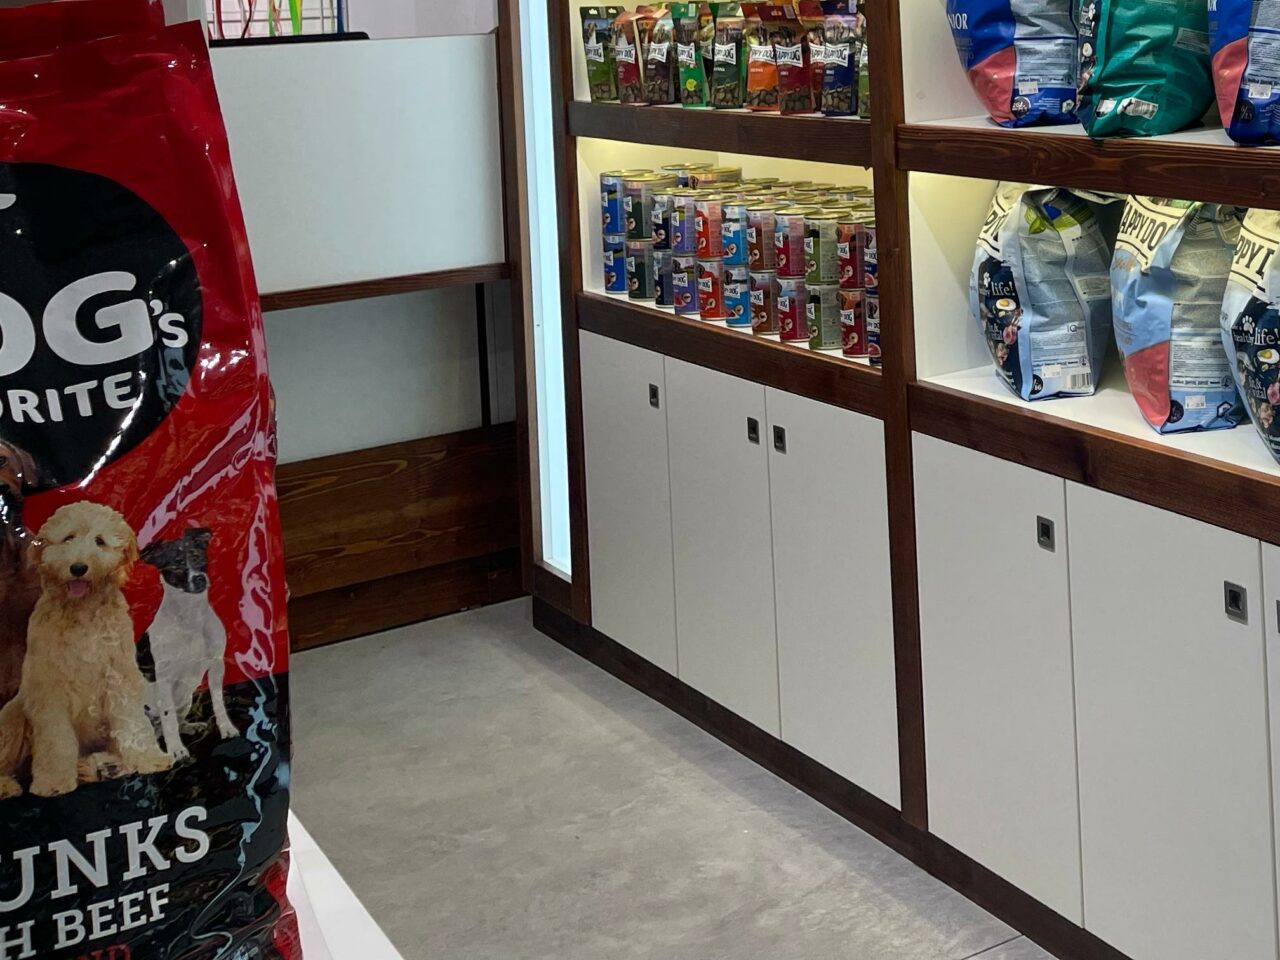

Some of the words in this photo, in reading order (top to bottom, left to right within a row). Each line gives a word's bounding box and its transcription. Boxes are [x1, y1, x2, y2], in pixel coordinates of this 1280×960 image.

[991, 281, 1015, 296] life!
[1254, 328, 1280, 346] life!
[0, 371, 138, 425] RITE
[52, 883, 170, 951] BEEF
